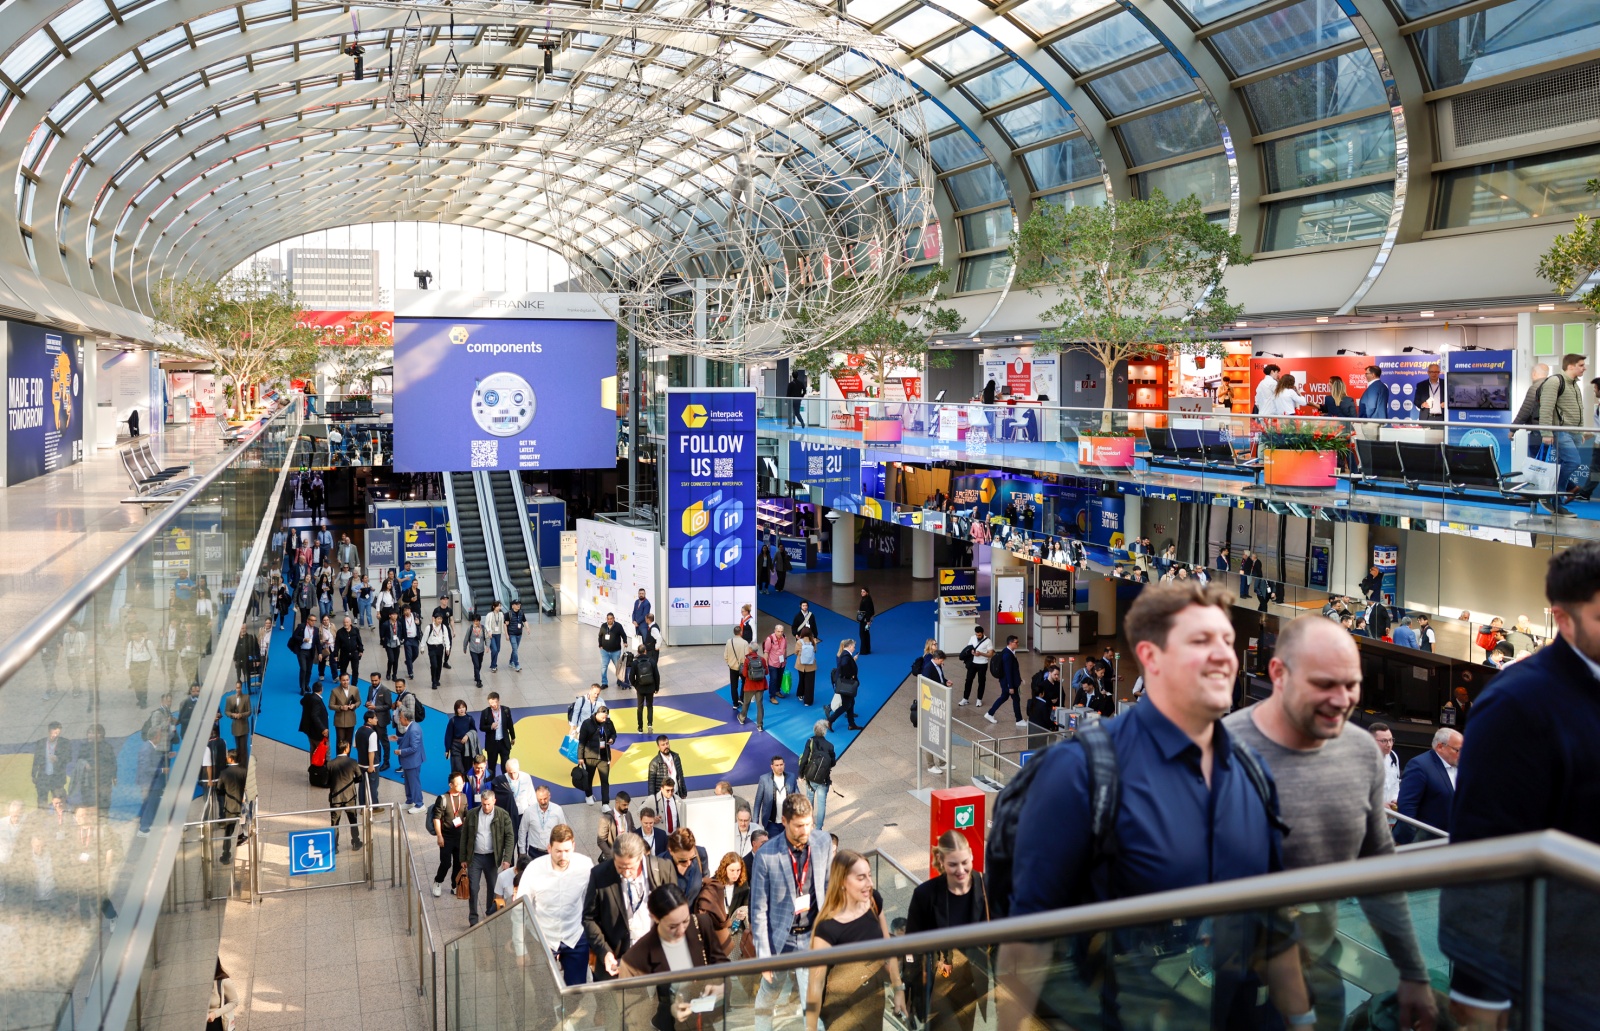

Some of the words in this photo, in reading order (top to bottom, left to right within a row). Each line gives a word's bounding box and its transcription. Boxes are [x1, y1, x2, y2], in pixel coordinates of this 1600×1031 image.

[490, 300, 544, 309] FRANKE
[466, 342, 542, 356] components
[9, 378, 29, 408] MADE
[31, 378, 43, 407] FOR
[9, 407, 43, 431] TOMORROW
[680, 435, 743, 453] FOLLOW
[691, 458, 711, 477] US
[1042, 580, 1067, 588] WELCOME
[1042, 587, 1067, 595] HOME
